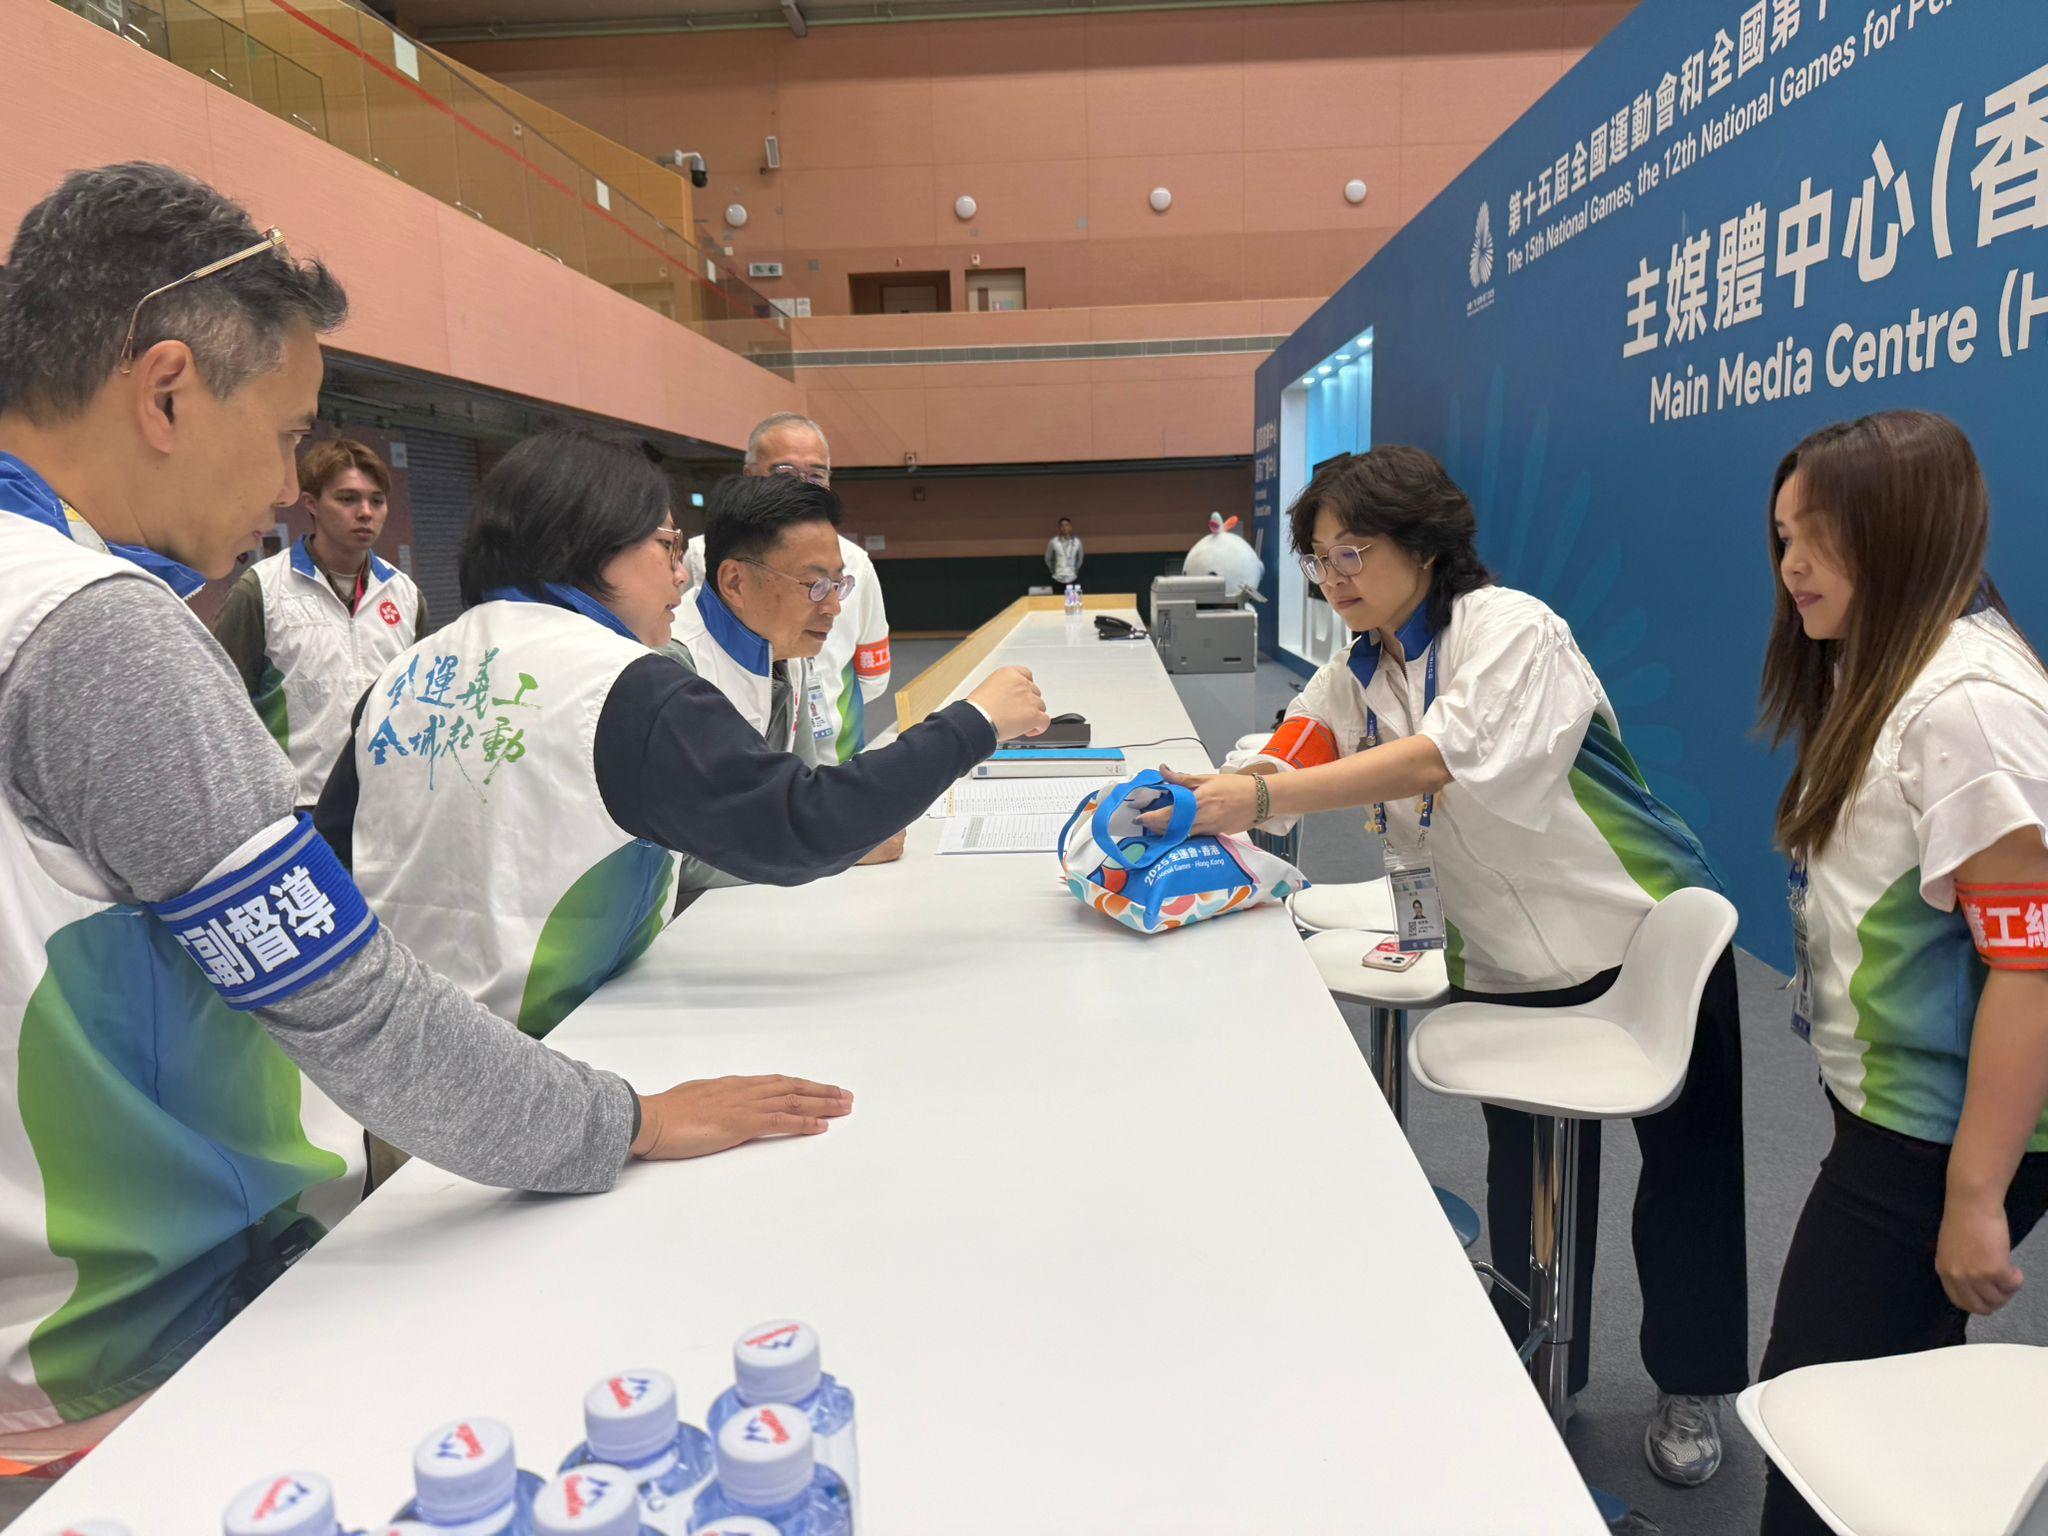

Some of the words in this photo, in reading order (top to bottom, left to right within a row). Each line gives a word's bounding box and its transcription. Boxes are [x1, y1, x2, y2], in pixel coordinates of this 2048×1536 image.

[1507, 249, 1523, 275] The
[1525, 232, 1544, 265] 15th
[1547, 200, 1588, 251] National
[1591, 180, 1635, 224] Games,
[1638, 161, 1660, 196] the
[1664, 132, 1697, 179] 12th
[1700, 77, 1774, 158] National
[1780, 35, 1856, 108] Games
[1863, 4, 1902, 57] for
[1508, 0, 1827, 237] 第十五屆全國運動會和全國第
[1650, 364, 1708, 423] Main
[1717, 336, 1813, 410] Media
[1825, 305, 1978, 388] Centre
[173, 865, 337, 988] 副督導
